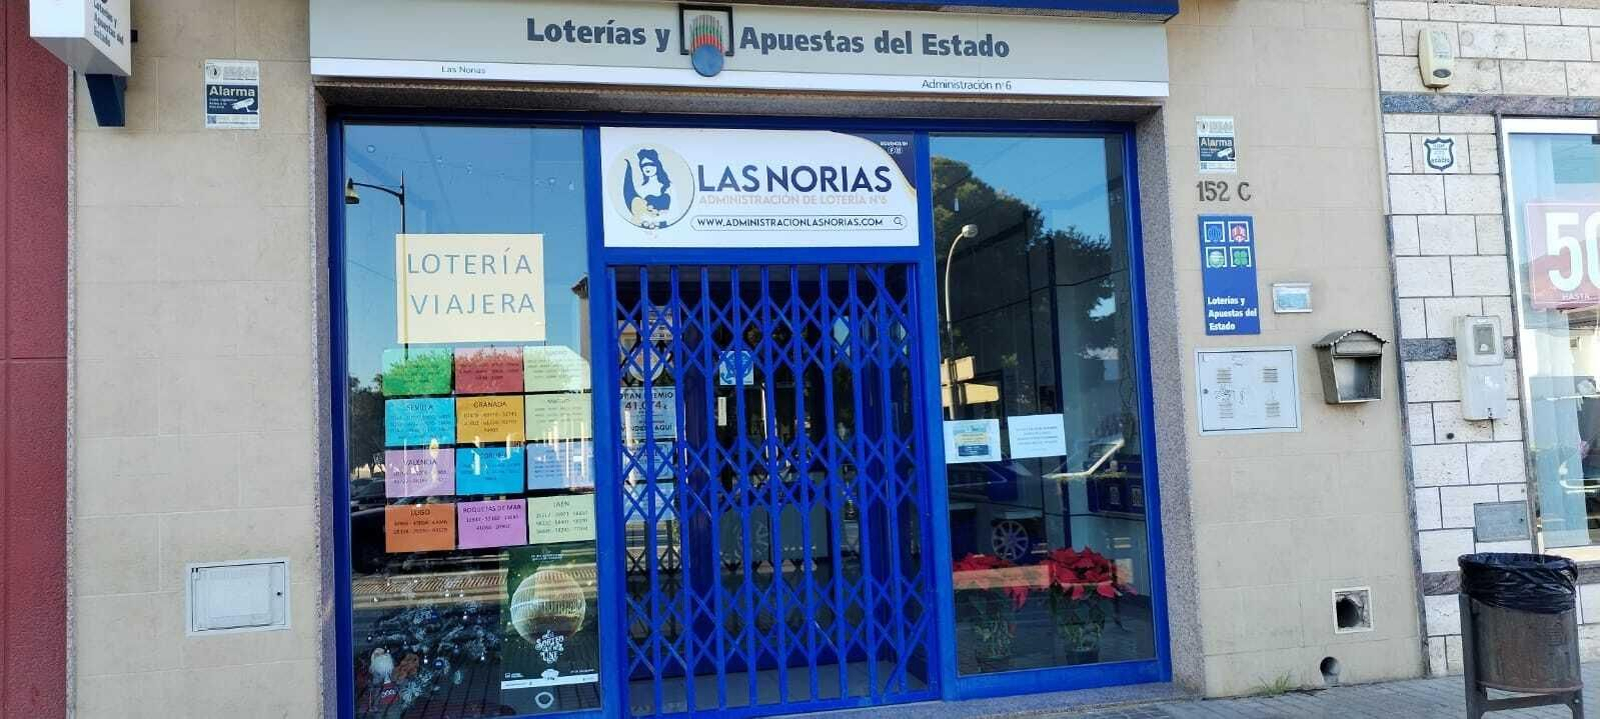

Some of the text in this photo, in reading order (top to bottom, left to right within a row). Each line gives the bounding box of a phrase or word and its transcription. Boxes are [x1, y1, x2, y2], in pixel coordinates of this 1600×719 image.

[526, 17, 670, 52] Loterías y
[739, 26, 1010, 57] Apuestas del Estado
[441, 65, 456, 73] Las
[921, 79, 993, 90] Administración
[209, 85, 256, 97] Alarma
[1200, 137, 1233, 147] Alarma
[697, 164, 893, 193] LAS NORIAS
[1196, 181, 1251, 202] 152 C
[699, 194, 800, 205] ADMINISTRACIÓN
[805, 195, 817, 205] DE
[821, 194, 867, 205] LOTERÍA
[697, 218, 884, 227] WWW.ADMINISTRACIONLASNORIAS.COM
[407, 248, 532, 275] LOTERÍA
[411, 293, 535, 314] VIAJERA
[1207, 296, 1239, 305] Loterías
[1208, 308, 1257, 319] Apuestas del
[1209, 322, 1236, 331] Estado
[473, 400, 507, 408] GRANADA
[410, 508, 431, 516] LUGO
[463, 504, 496, 513] ROQUETAS
